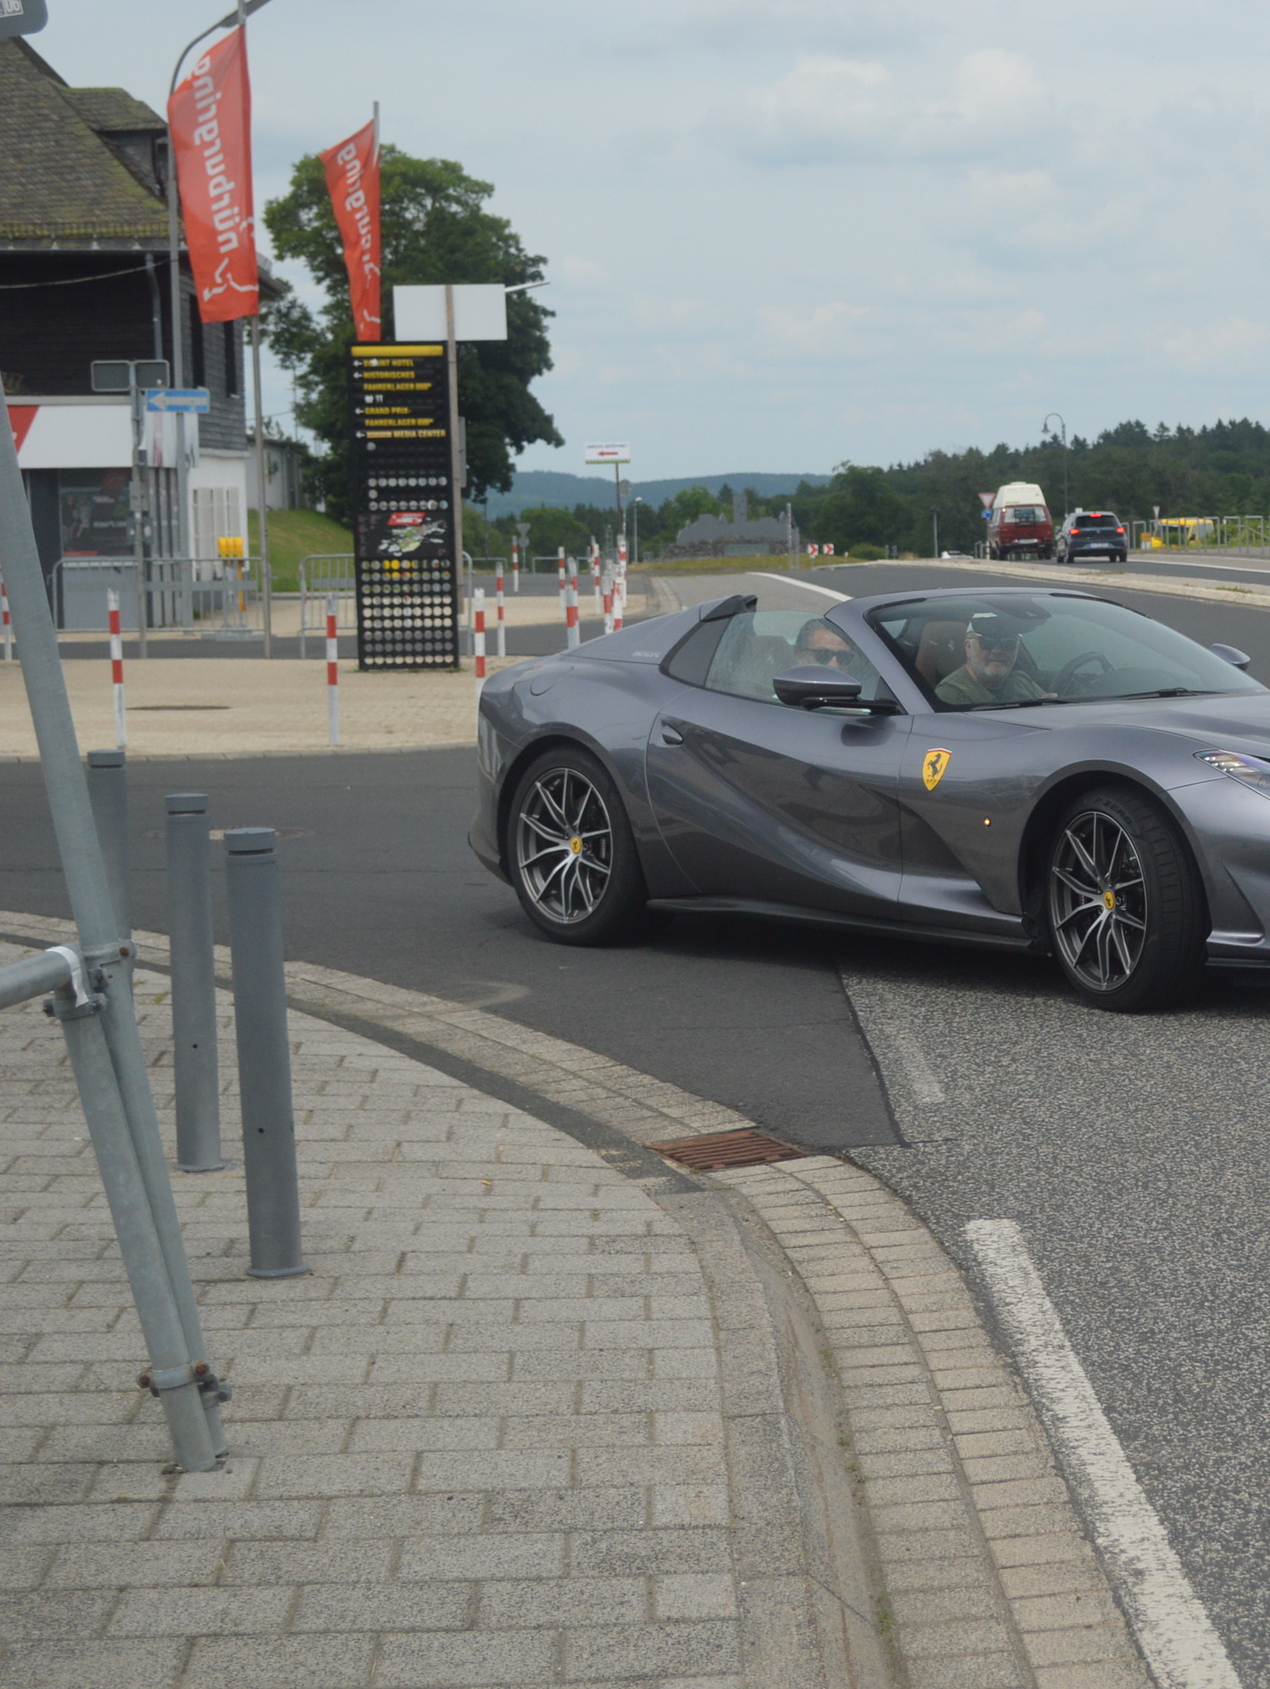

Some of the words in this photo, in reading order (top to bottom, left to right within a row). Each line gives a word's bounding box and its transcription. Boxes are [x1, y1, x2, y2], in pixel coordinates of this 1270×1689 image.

[391, 359, 415, 367] HOTEL
[363, 371, 415, 379] HISTORISCHES
[363, 382, 415, 391] FAHRERLAGER
[365, 407, 390, 415] GRAND
[365, 418, 417, 426] FAHRERLAGER
[393, 430, 417, 438] MEDIA
[418, 429, 446, 438] CENTER
